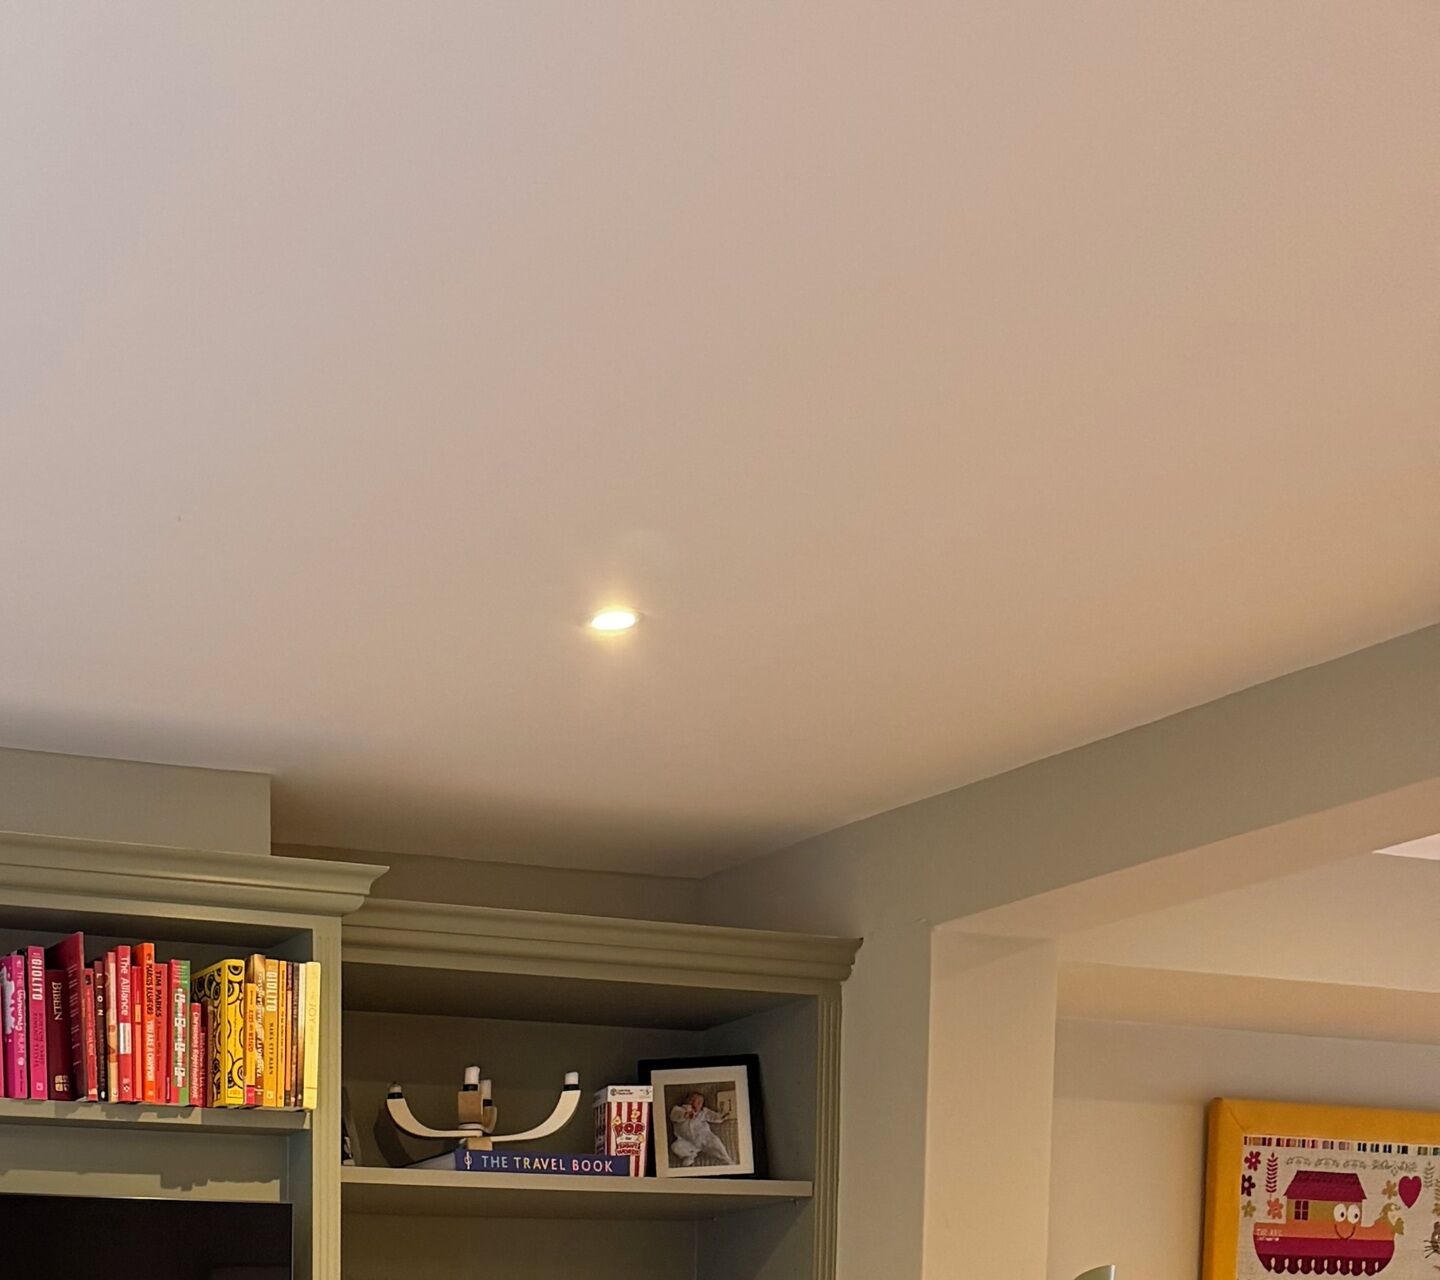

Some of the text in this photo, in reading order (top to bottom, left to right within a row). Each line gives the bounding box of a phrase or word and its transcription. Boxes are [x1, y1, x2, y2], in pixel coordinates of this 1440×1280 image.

[31, 958, 42, 1000] GIOLITO
[265, 971, 276, 1011] GIOLITO
[51, 981, 62, 1020] BIBELN
[482, 1155, 612, 1172] THE TRAVEL BOOK
